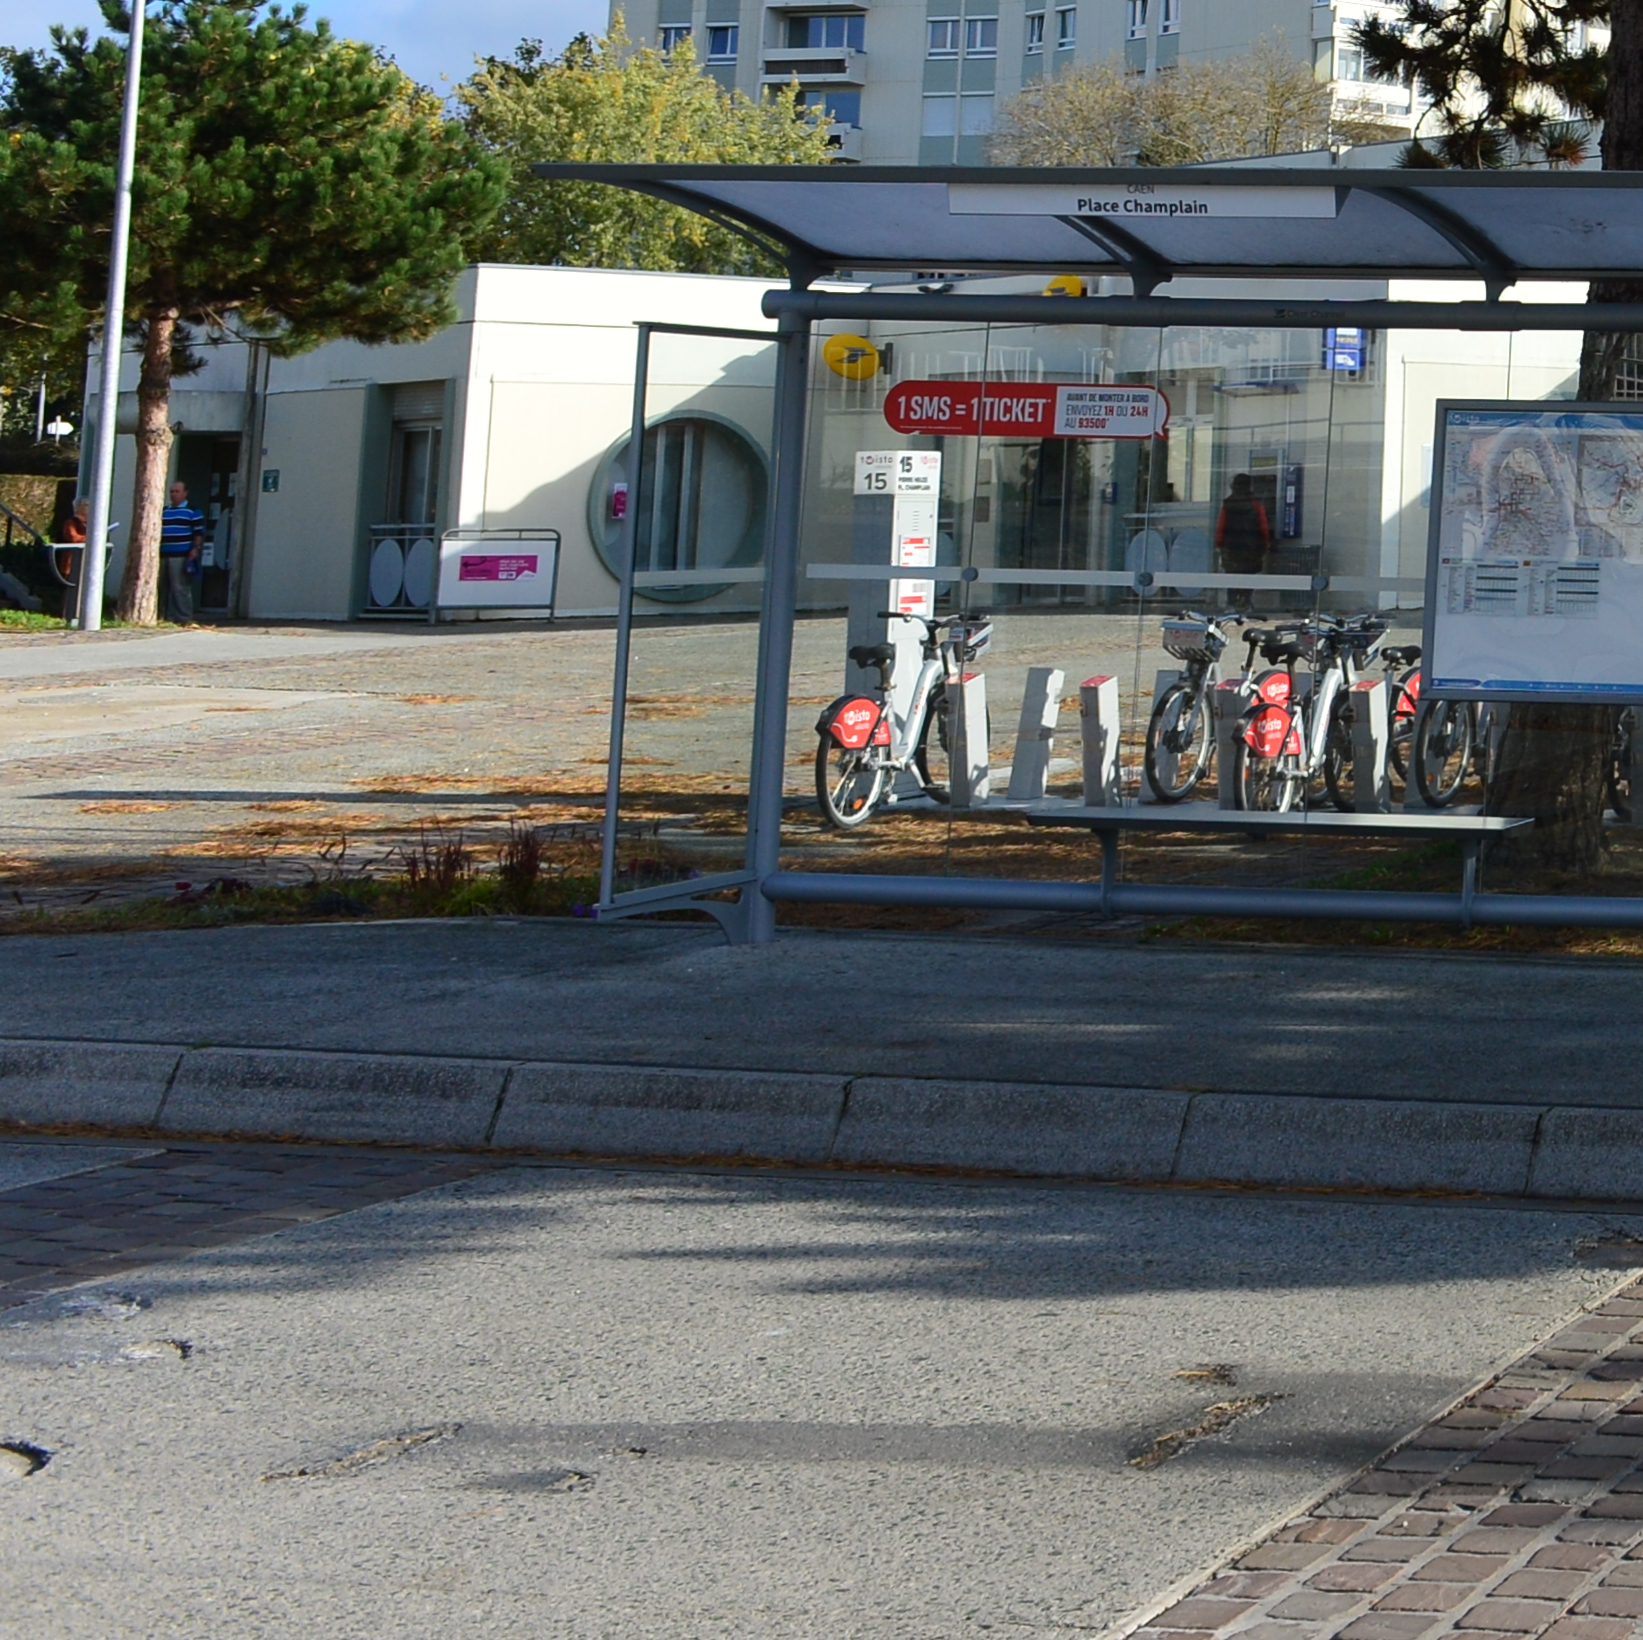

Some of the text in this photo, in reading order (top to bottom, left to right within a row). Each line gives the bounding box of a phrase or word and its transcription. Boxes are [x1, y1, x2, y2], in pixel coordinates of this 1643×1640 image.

[1127, 184, 1155, 194] CAEN
[1077, 198, 1208, 217] Place Champlain
[1088, 393, 1098, 402] DE
[898, 395, 906, 420] 1
[910, 395, 952, 420] SMS
[955, 403, 967, 415] =
[970, 396, 978, 421] 1
[1066, 404, 1149, 417] ENVOYEZ 1H OU 24H
[1064, 417, 1076, 428] AU
[899, 455, 913, 473] 15
[864, 472, 887, 491] 15
